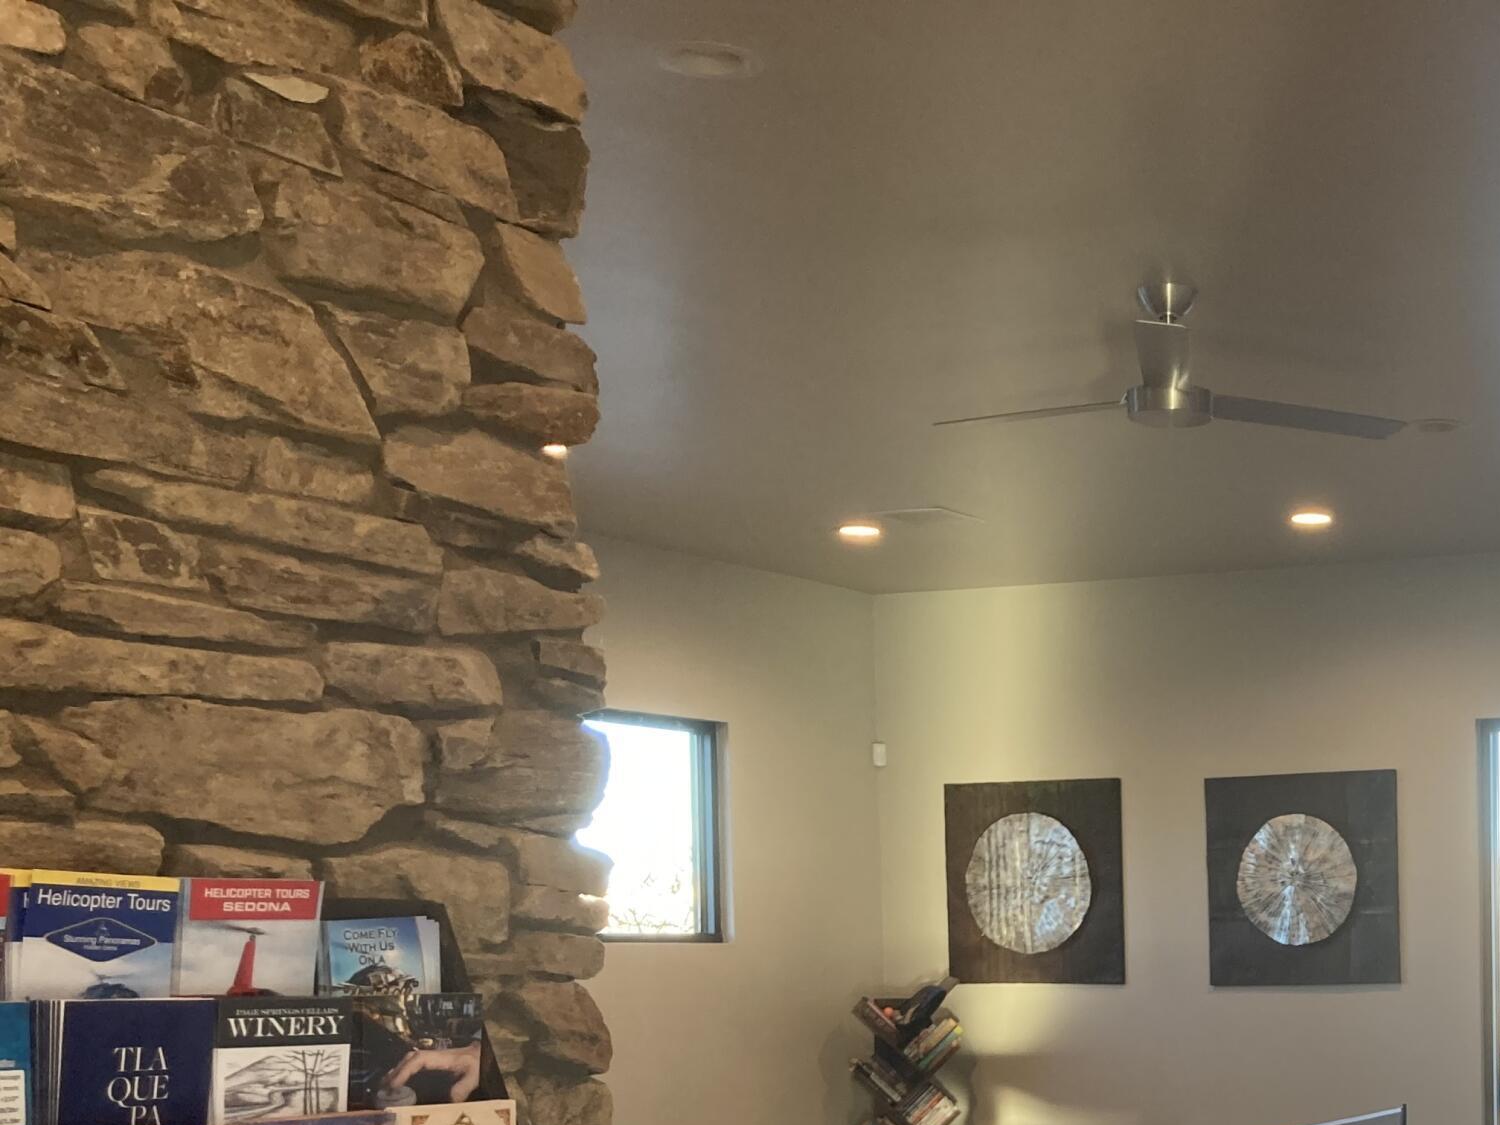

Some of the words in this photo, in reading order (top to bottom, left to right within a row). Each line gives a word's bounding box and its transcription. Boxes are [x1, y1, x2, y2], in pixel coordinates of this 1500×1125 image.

[38, 888, 122, 912] Helicopter
[127, 893, 171, 912] Tours
[205, 888, 272, 899] HELICOPTER
[275, 889, 310, 899] TOURS
[222, 902, 292, 912] SEDONA
[343, 929, 375, 941] COME
[378, 928, 398, 938] FLY
[349, 942, 376, 953] WITH
[379, 942, 395, 951] US
[358, 955, 376, 965] ON
[379, 956, 386, 964] A
[227, 1015, 345, 1038] WINERY
[114, 1046, 169, 1073] TLA
[107, 1075, 169, 1108] QUE
